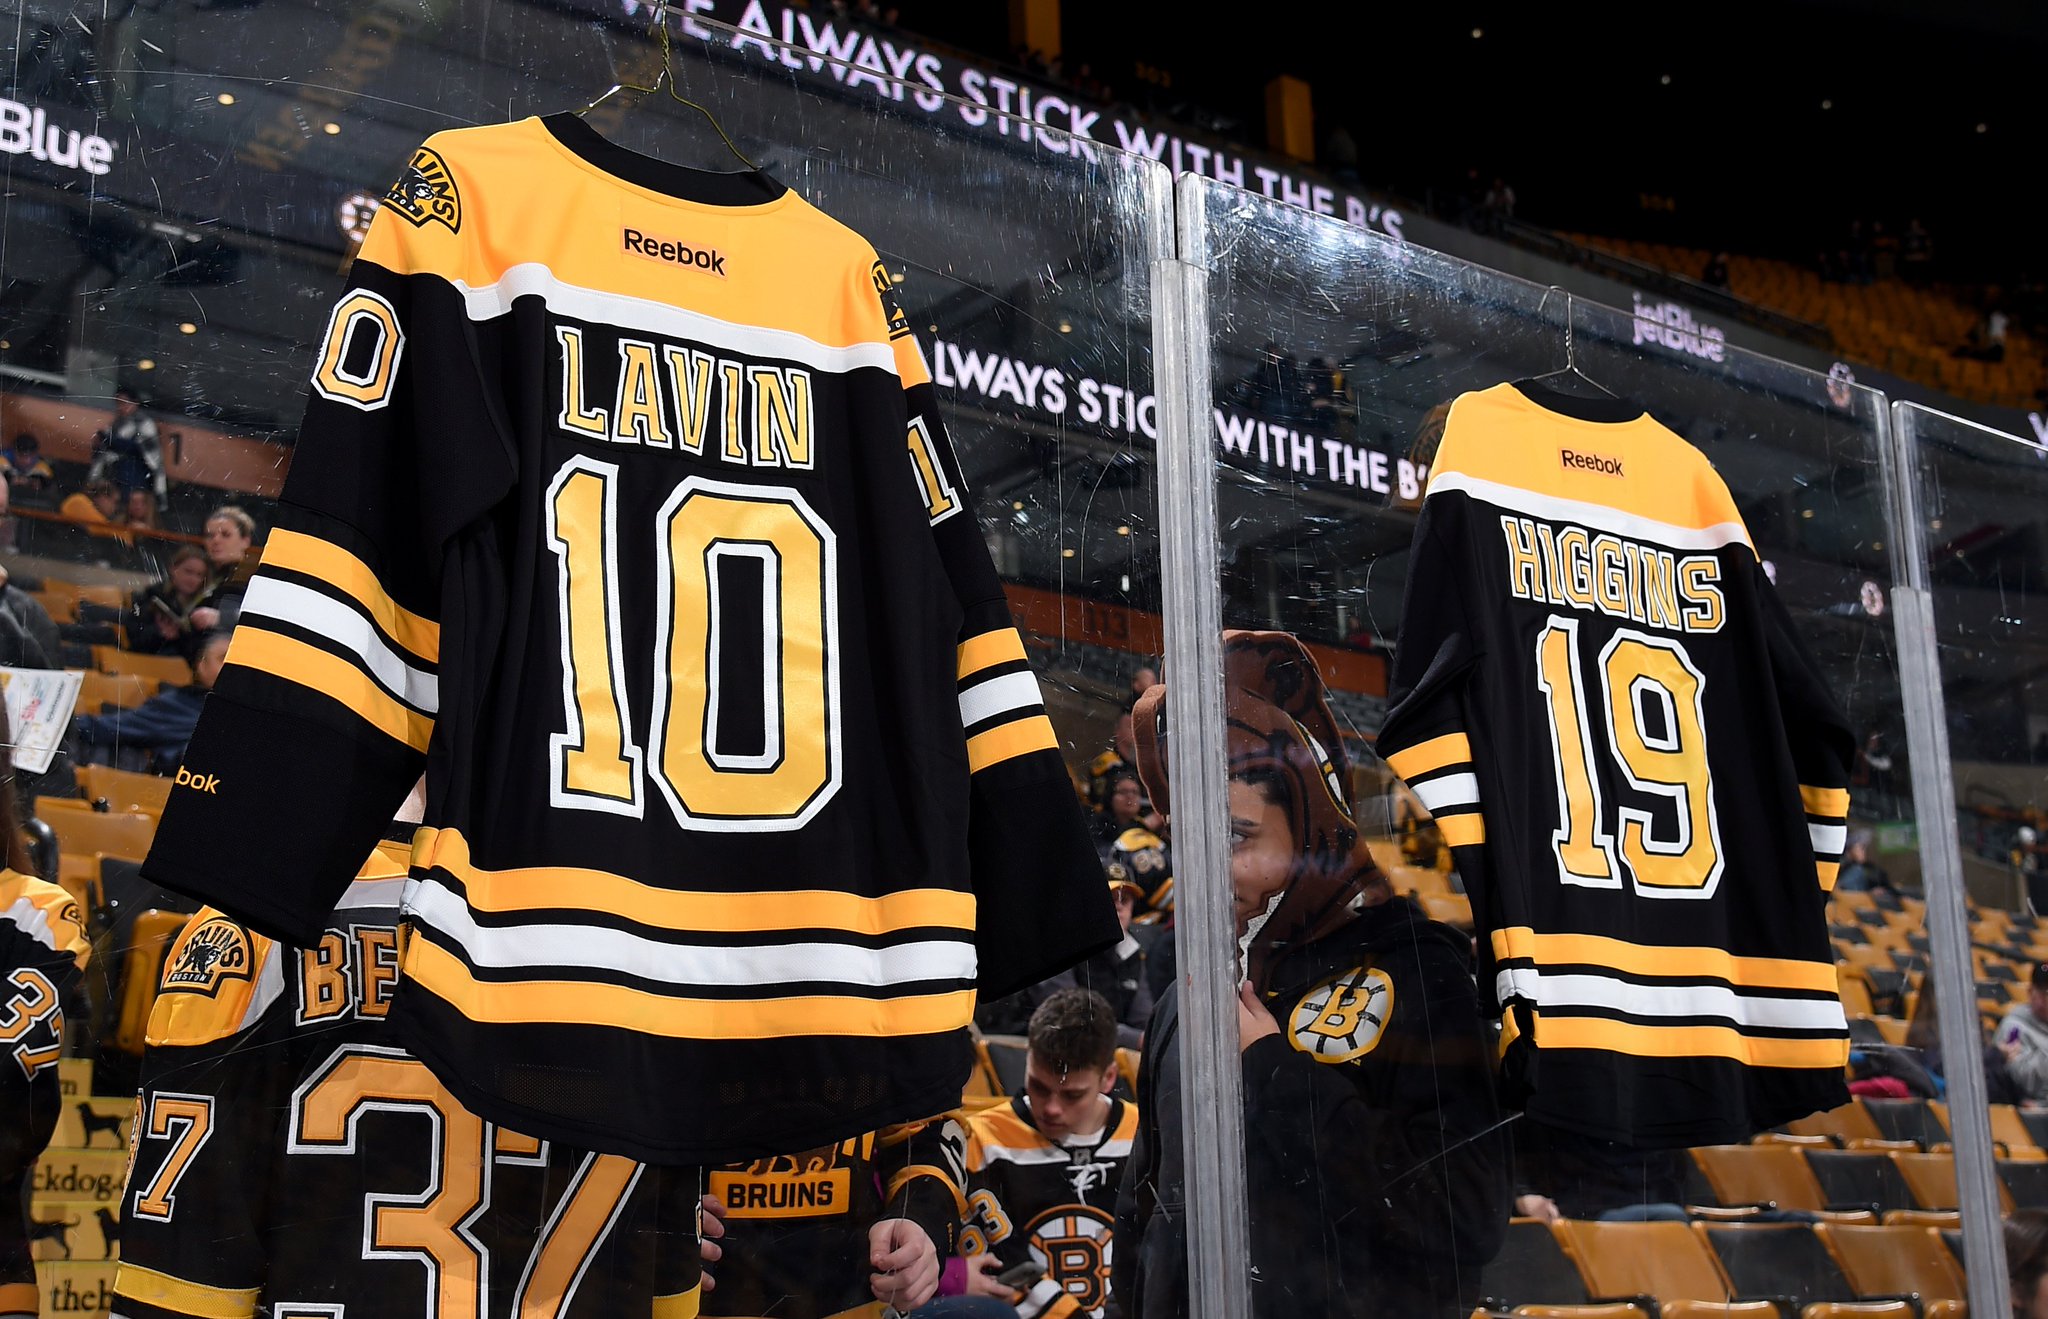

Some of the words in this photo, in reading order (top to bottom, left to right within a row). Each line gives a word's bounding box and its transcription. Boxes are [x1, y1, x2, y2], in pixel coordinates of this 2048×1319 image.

[730, 0, 946, 112] ALWAYS
[957, 67, 1103, 165] STICK
[624, 227, 725, 276] Reebok
[311, 288, 404, 411] 0
[556, 326, 814, 471] LAVIN
[918, 338, 1067, 414] LWAYS
[1078, 378, 1157, 440] STIC
[1214, 409, 1316, 476] WITH
[1321, 438, 1391, 495] THE
[1397, 458, 1431, 500] B'
[1562, 449, 1624, 478] Reebok
[1500, 515, 1726, 633] HIGGINS
[547, 454, 842, 832] 10
[175, 765, 221, 794] bok
[1537, 615, 1726, 899] 19
[121, 1088, 215, 1223] 7
[727, 1180, 834, 1209] BRUINS
